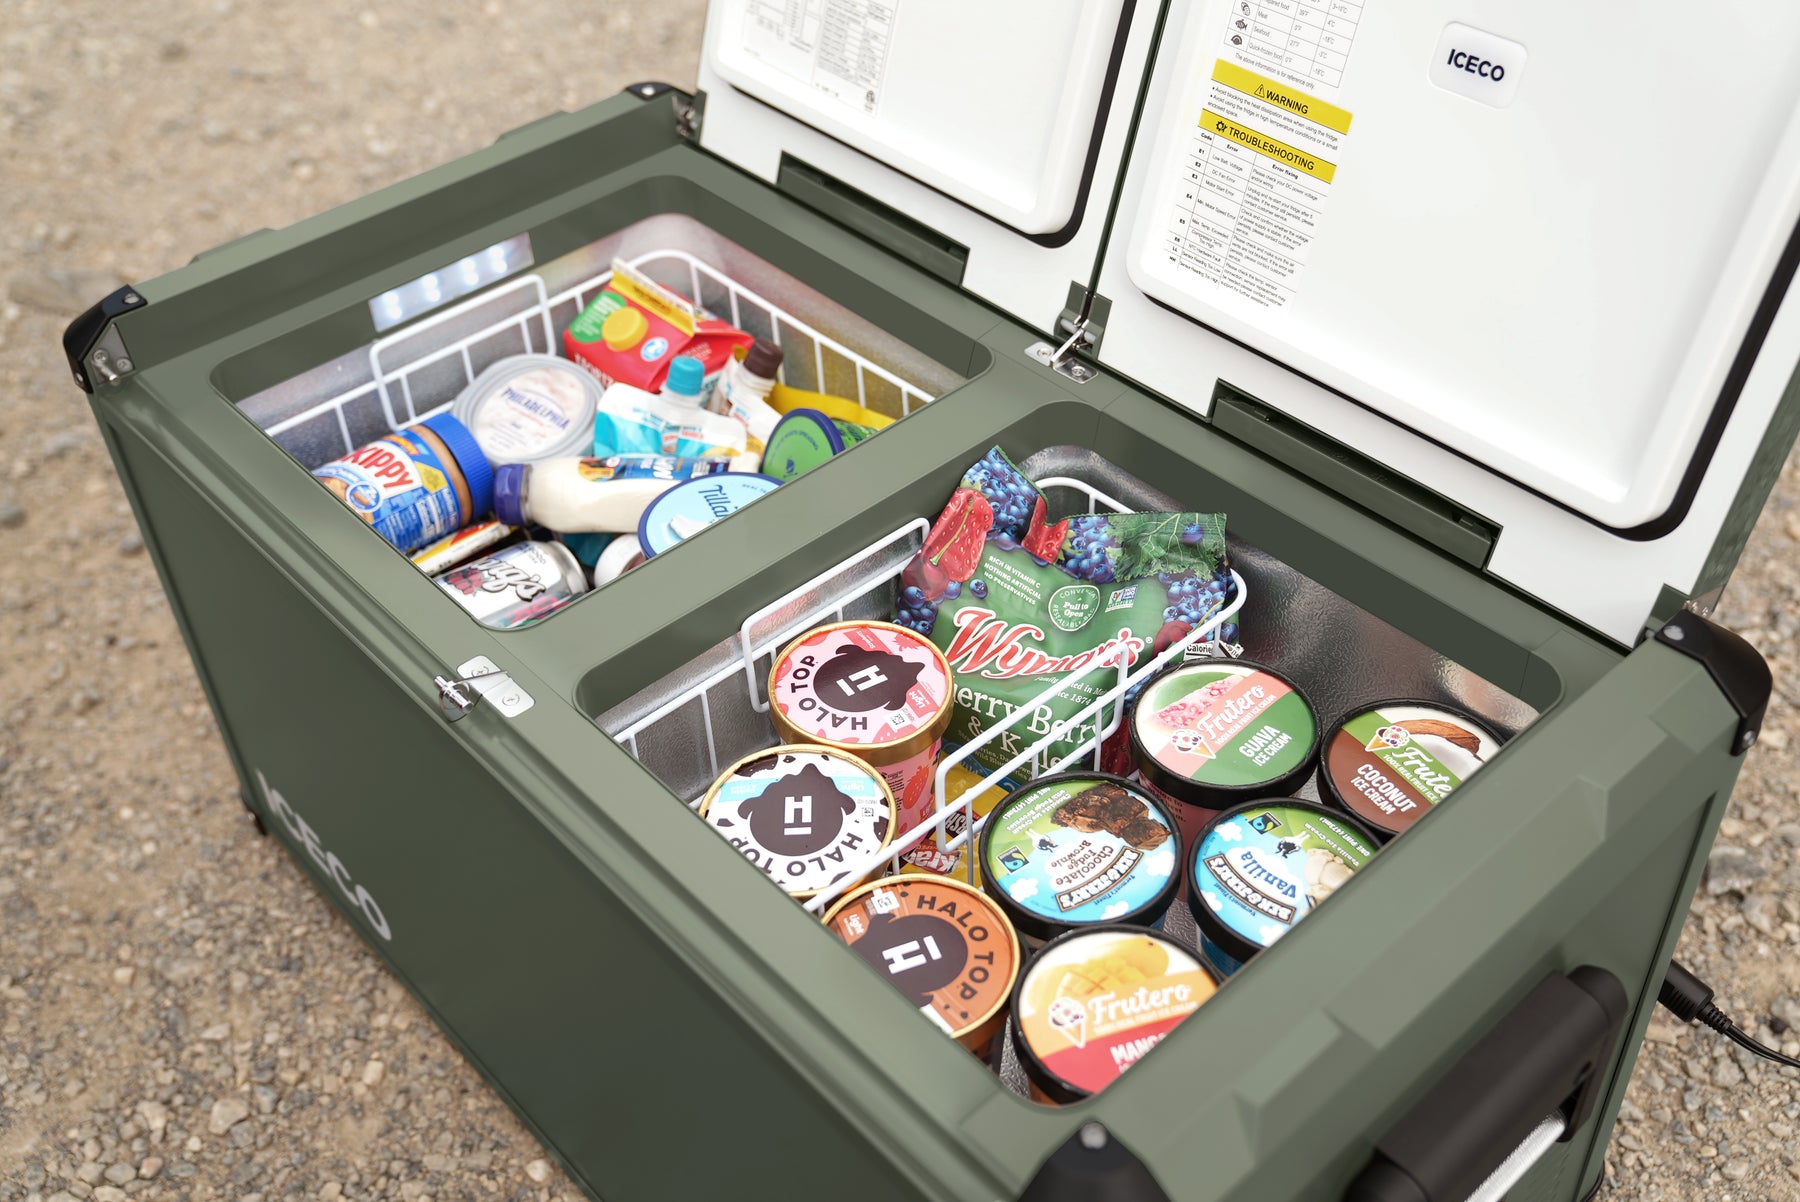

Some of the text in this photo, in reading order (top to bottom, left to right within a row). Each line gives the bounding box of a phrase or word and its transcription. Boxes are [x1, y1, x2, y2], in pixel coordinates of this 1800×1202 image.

[1254, 26, 1270, 37] Seafood
[1258, 11, 1267, 19] Meat
[1447, 48, 1504, 82] ICECO
[1266, 89, 1308, 115] WARNING
[1201, 132, 1212, 141] Code
[1227, 144, 1238, 152] Error
[1228, 127, 1314, 171] TROUBLESHOOTING
[1272, 164, 1298, 180] Error fixing
[340, 446, 414, 489] KIPPY
[698, 484, 731, 518] Tilla
[984, 562, 1011, 582] NOTHING
[1010, 578, 1041, 600] ARTIFICIAL
[989, 556, 1004, 568] RICH
[1004, 563, 1012, 572] IN
[1012, 566, 1035, 585] VITAMIN
[984, 571, 993, 580] NO
[993, 574, 1036, 606] PRESERVATIVES
[1063, 602, 1080, 610] Pull
[1064, 610, 1084, 618] Open
[790, 654, 868, 730] HALO TOP
[908, 690, 926, 708] Light
[1196, 685, 1265, 740] Frutero
[1239, 725, 1280, 758] GUAVA
[1252, 732, 1292, 766] ICE CREAM
[1357, 764, 1417, 812] COCONUT
[1392, 747, 1453, 798] Frute
[1397, 766, 1412, 780] REAL
[1410, 778, 1427, 793] FRUIT
[1425, 790, 1438, 801] ICE
[1350, 776, 1396, 815] ICE CREAM
[256, 769, 392, 941] ICECO
[729, 832, 863, 876] HALO TOP
[1050, 839, 1092, 869] Brownie
[1055, 844, 1114, 886] Chocolate
[1066, 848, 1097, 871] Fudge
[1335, 846, 1361, 867] Vanilla
[1356, 844, 1371, 857] ONE
[1110, 874, 1136, 899] Vermont's
[1240, 850, 1296, 898] Vanilla
[1228, 895, 1256, 917] Vermont's
[849, 913, 865, 936] Light
[916, 894, 988, 942] HALO
[959, 951, 994, 1000] TOP
[1088, 984, 1192, 1025] Frutero
